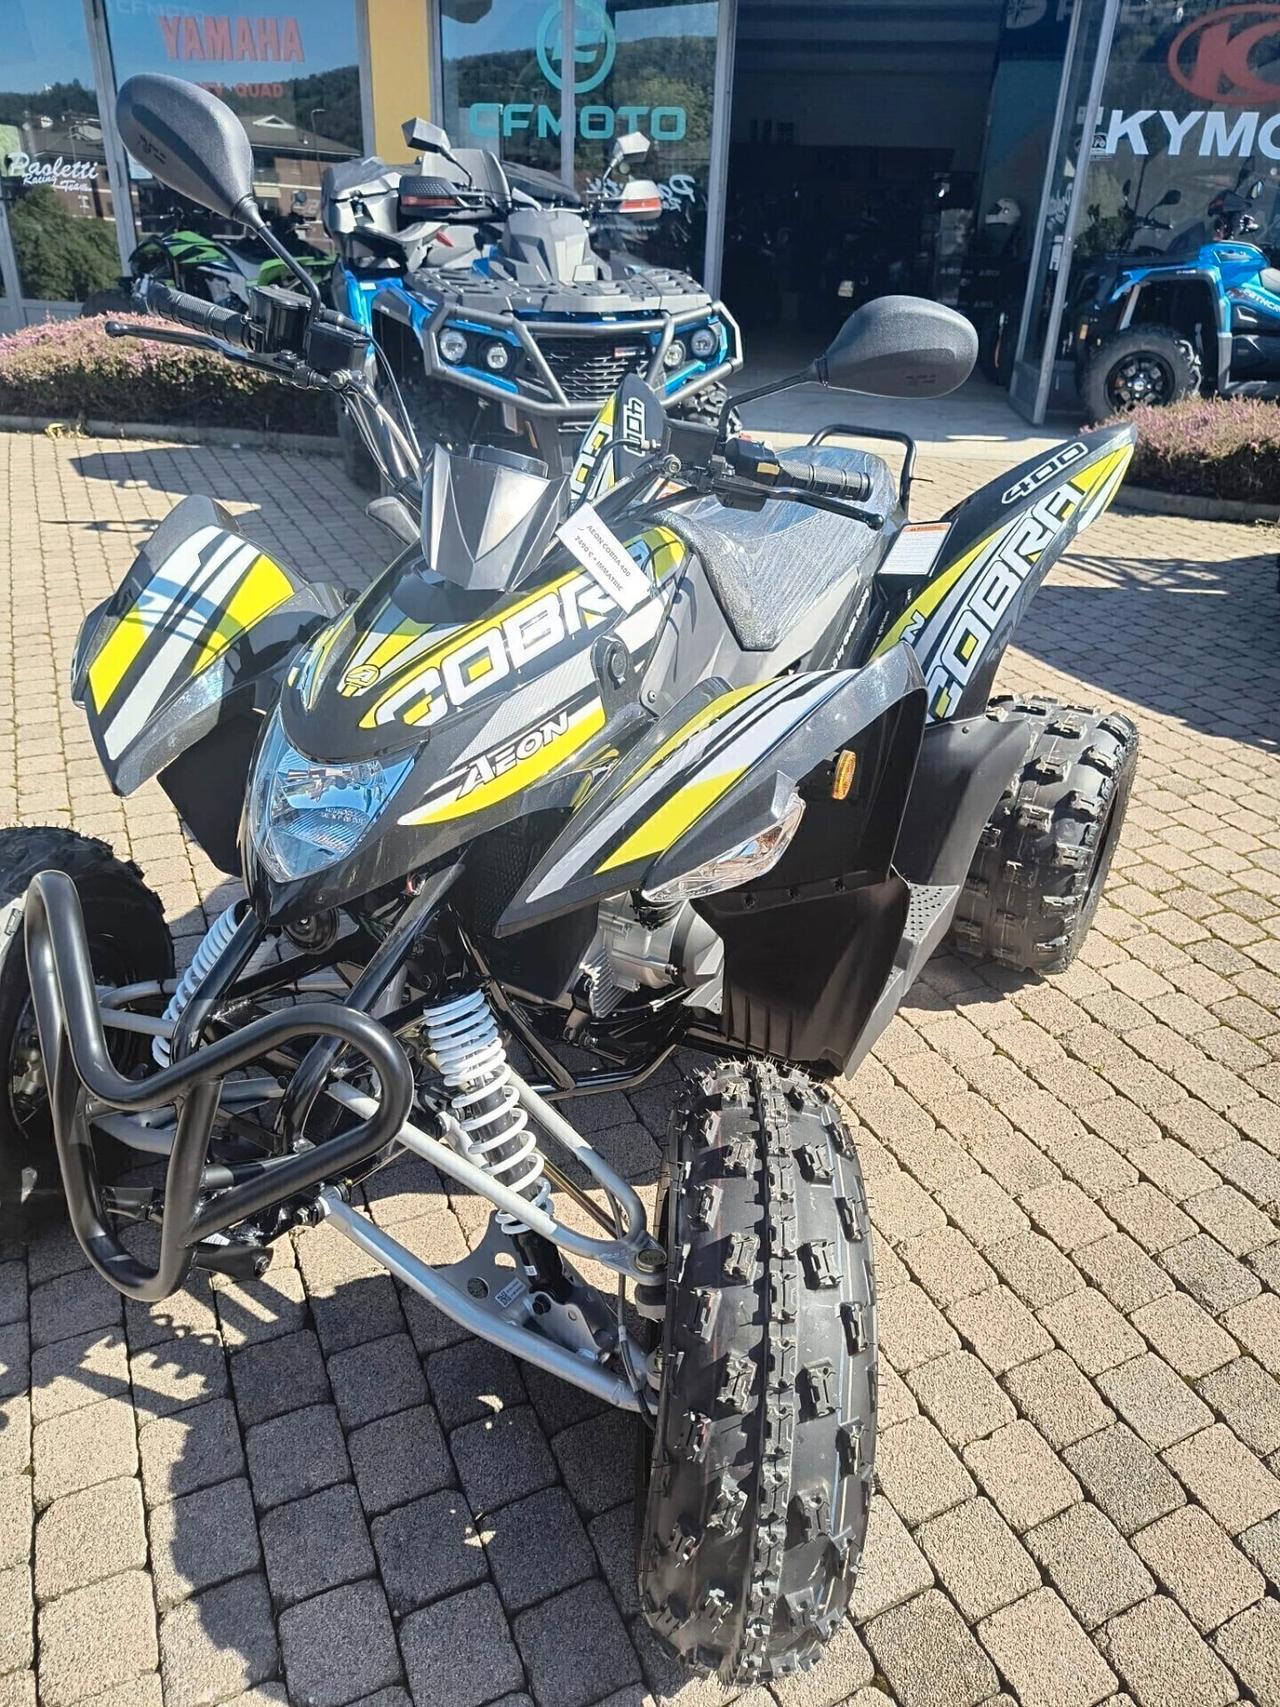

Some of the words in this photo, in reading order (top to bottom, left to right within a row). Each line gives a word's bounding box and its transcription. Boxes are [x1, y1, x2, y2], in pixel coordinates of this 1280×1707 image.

[159, 16, 304, 62] YAMAHA
[235, 83, 284, 97] QUAD
[469, 103, 687, 141] CFMOTO
[8, 152, 99, 179] Paoletti
[1001, 442, 1088, 504] 400
[586, 525, 603, 545] AEON
[602, 543, 621, 566] COBRA
[926, 481, 1087, 721] COBRA
[376, 542, 650, 727] COBR
[456, 711, 570, 800] AEON
